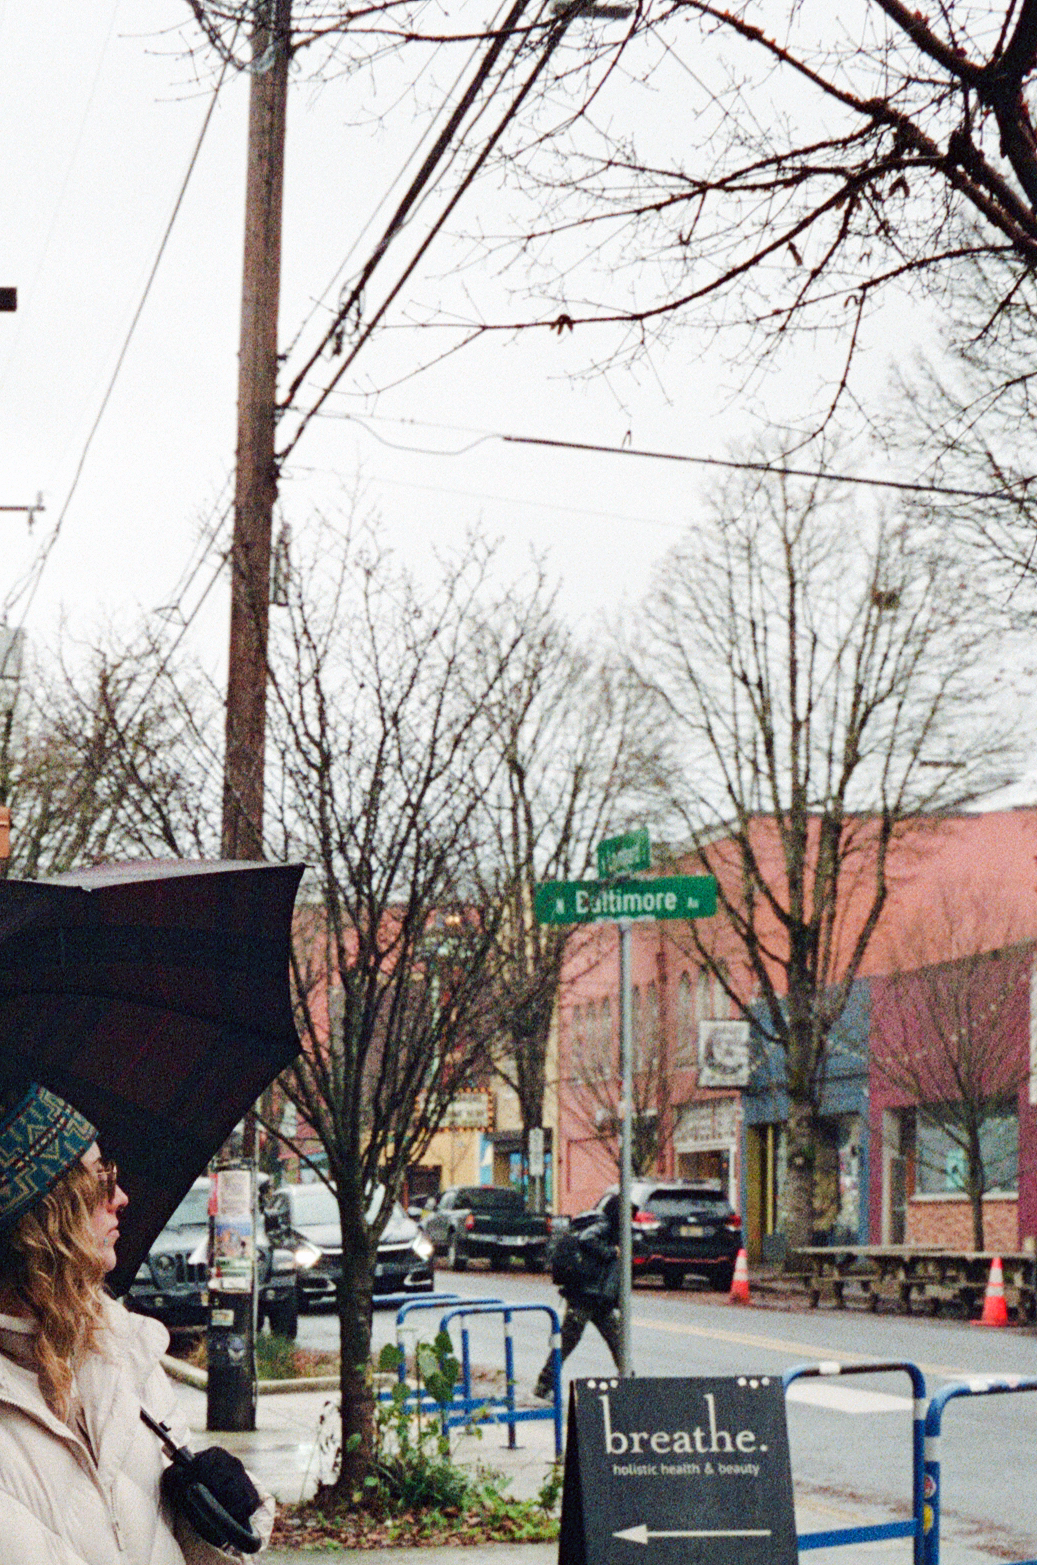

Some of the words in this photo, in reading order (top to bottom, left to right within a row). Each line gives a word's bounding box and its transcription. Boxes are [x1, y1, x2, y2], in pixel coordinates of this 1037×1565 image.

[555, 897, 565, 915] N
[598, 1393, 769, 1455] breathe.
[613, 1463, 658, 1476] holistic
[661, 1463, 700, 1476] health
[704, 1462, 715, 1476] &
[718, 1462, 760, 1478] beauty
